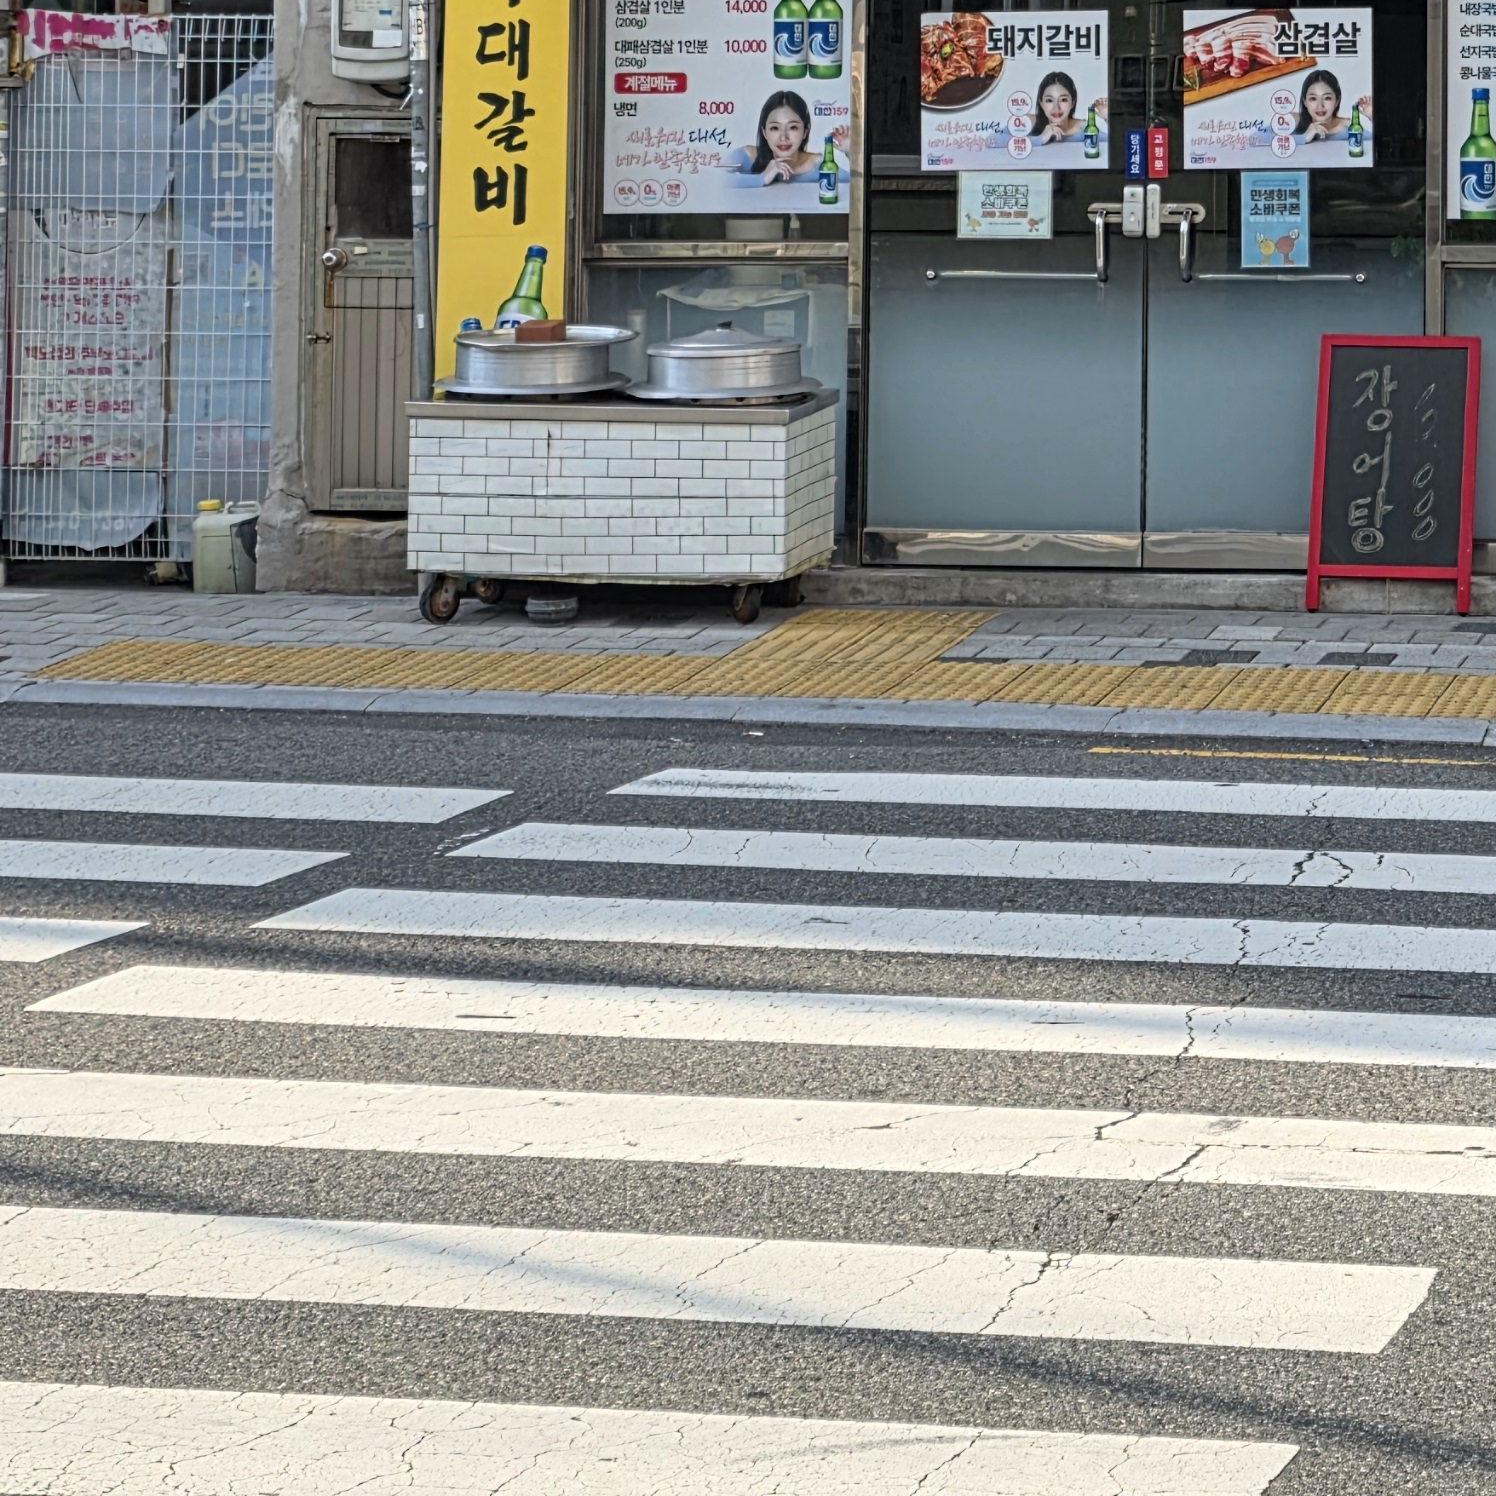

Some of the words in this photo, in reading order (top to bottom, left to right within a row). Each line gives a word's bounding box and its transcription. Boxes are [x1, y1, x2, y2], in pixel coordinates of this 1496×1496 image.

[615, 0, 651, 14] 삼겹살
[654, 0, 685, 14] 1인분
[725, 0, 768, 14] 14,000
[615, 16, 647, 29] (200g)
[986, 22, 1102, 57] 돼지갈비
[1273, 21, 1361, 56] 삼겹살
[615, 39, 675, 54] 대패삼겹살
[677, 39, 708, 54] 1인분
[724, 39, 768, 54] 10,000
[615, 57, 647, 69] (250g)
[624, 75, 678, 91] 계절메뉴
[613, 102, 637, 117] 냉면
[699, 102, 734, 116] 8,000
[1130, 134, 1140, 173] 당기세요
[982, 184, 1028, 197] 민생회복
[1250, 189, 1300, 201] 민생회복
[981, 197, 1028, 209] 소비쿠폰
[1250, 203, 1300, 216] 소비쿠폰
[1349, 365, 1398, 553] 장어탕
